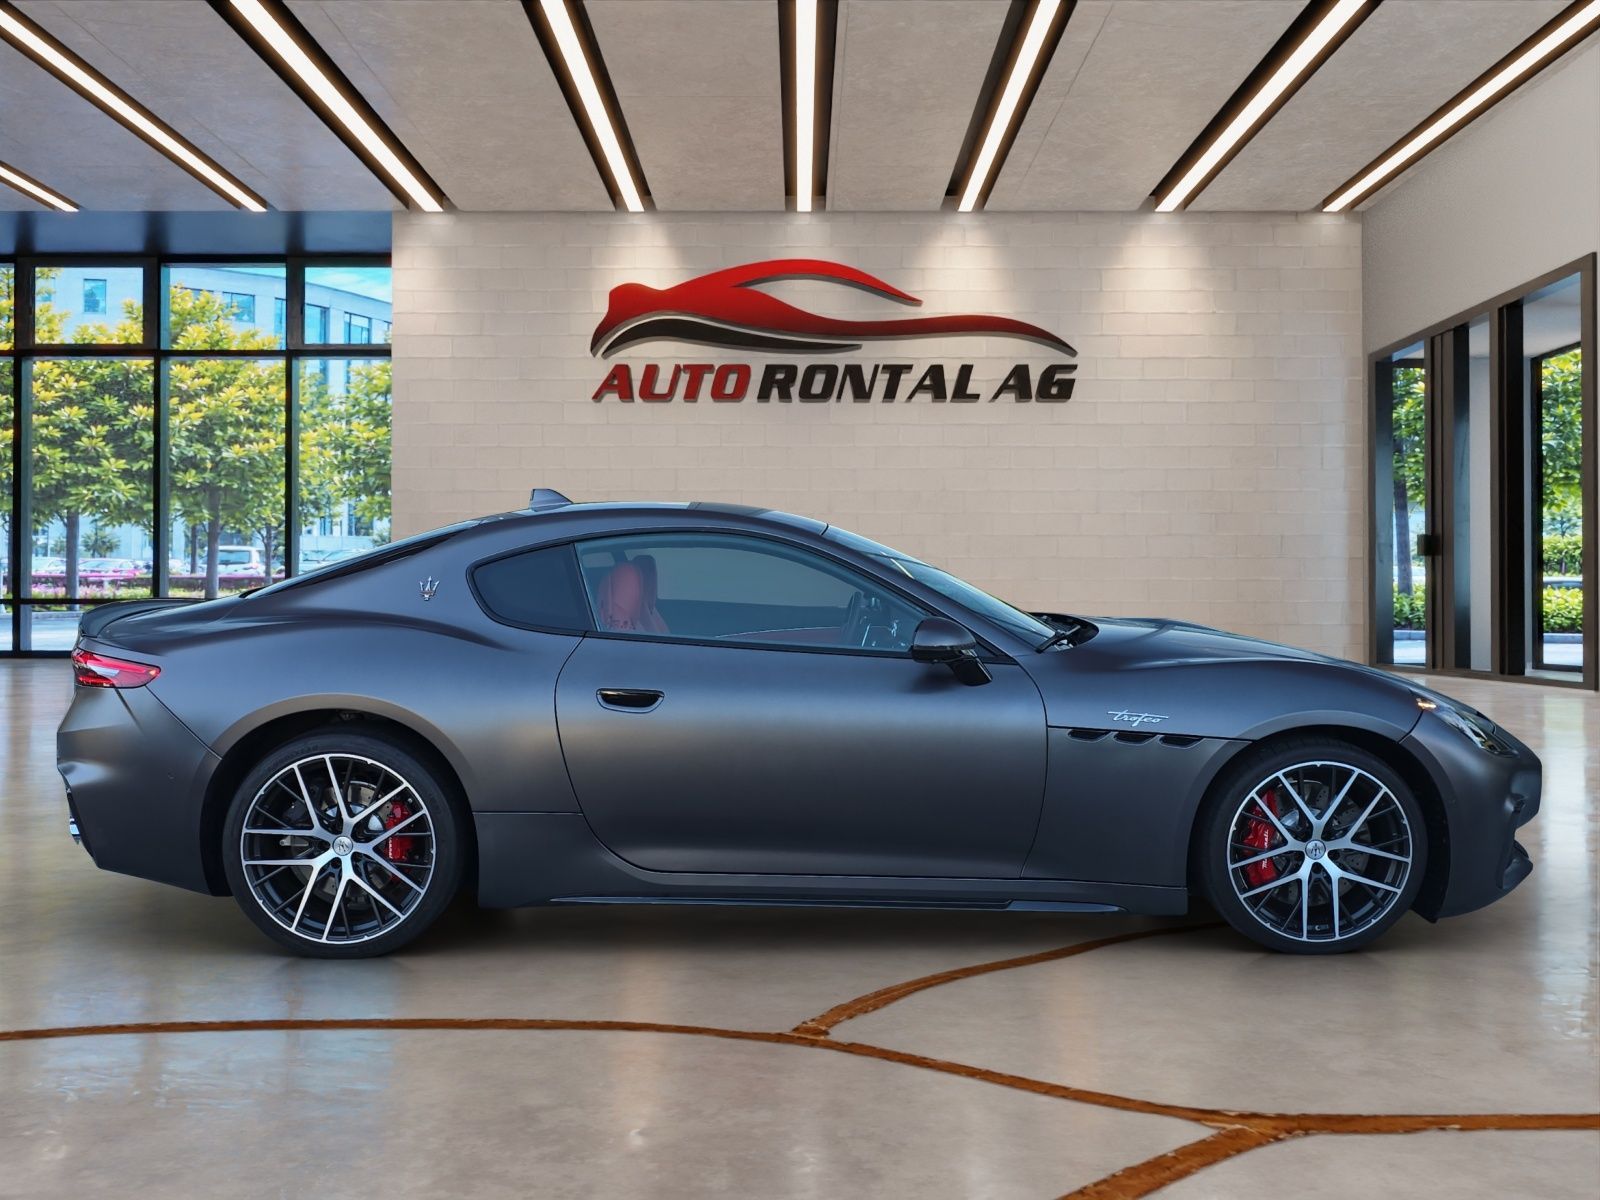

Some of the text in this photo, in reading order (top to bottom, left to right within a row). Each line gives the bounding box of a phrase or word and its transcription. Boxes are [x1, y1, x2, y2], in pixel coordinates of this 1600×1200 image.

[591, 364, 1078, 402] AUTO RONTAL AG
